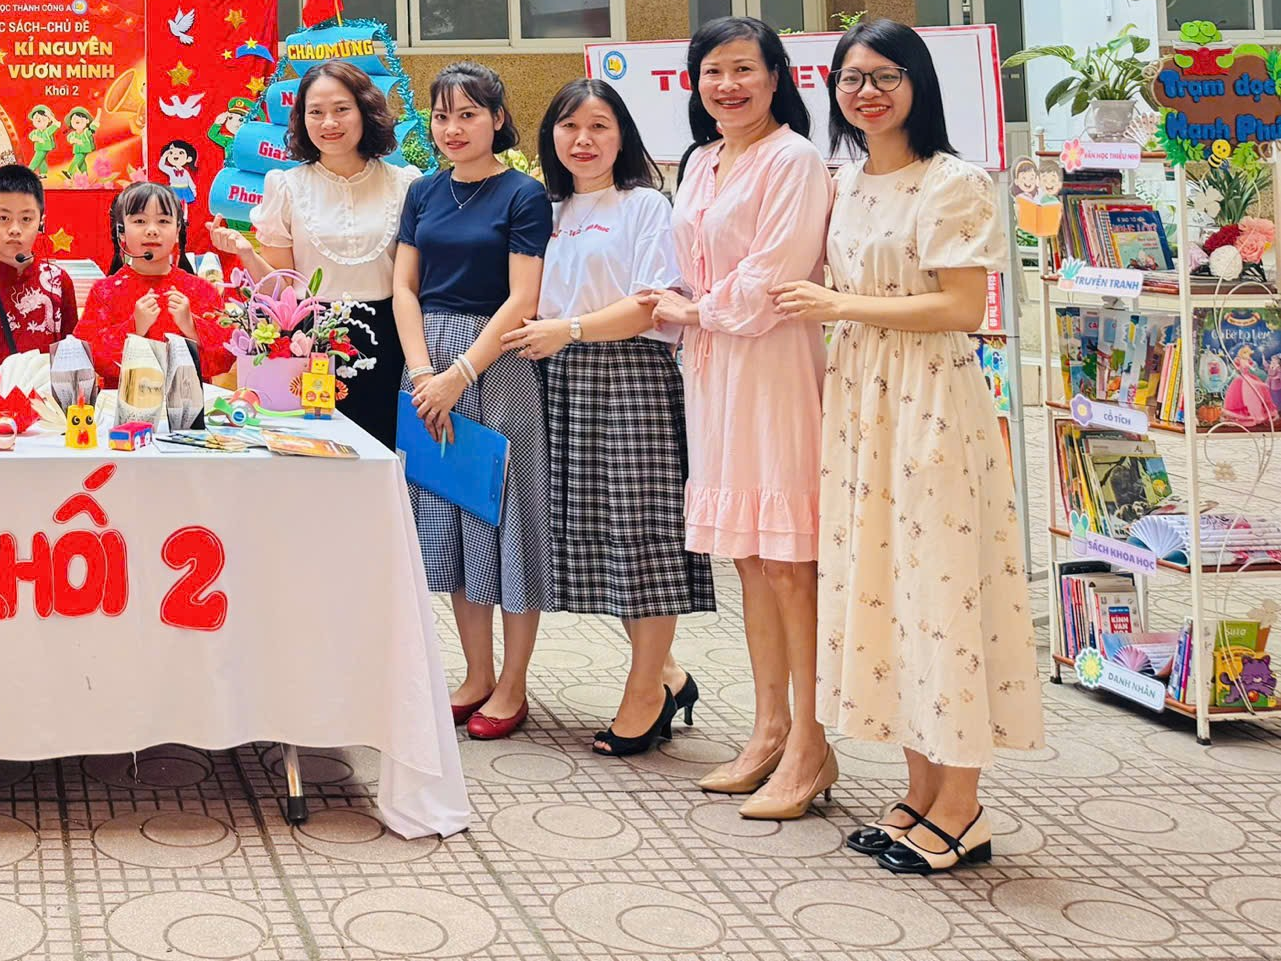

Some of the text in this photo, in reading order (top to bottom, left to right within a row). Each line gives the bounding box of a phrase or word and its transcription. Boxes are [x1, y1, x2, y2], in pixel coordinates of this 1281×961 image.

[13, 2, 40, 12] THÀNH
[42, 2, 64, 12] CÔNG
[15, 35, 113, 57] KỈ NGUYÊN
[8, 58, 115, 79] VƯƠN MÌNH
[45, 85, 79, 96] Khối 2
[1158, 69, 1224, 103] Trạm
[1166, 111, 1281, 146] Hạnh Phú
[1110, 279, 1140, 290] TRANH
[1088, 539, 1155, 570] SÁCH KHOA HỌC
[159, 525, 228, 632] 2
[1108, 672, 1156, 699] DANH NHÂN
